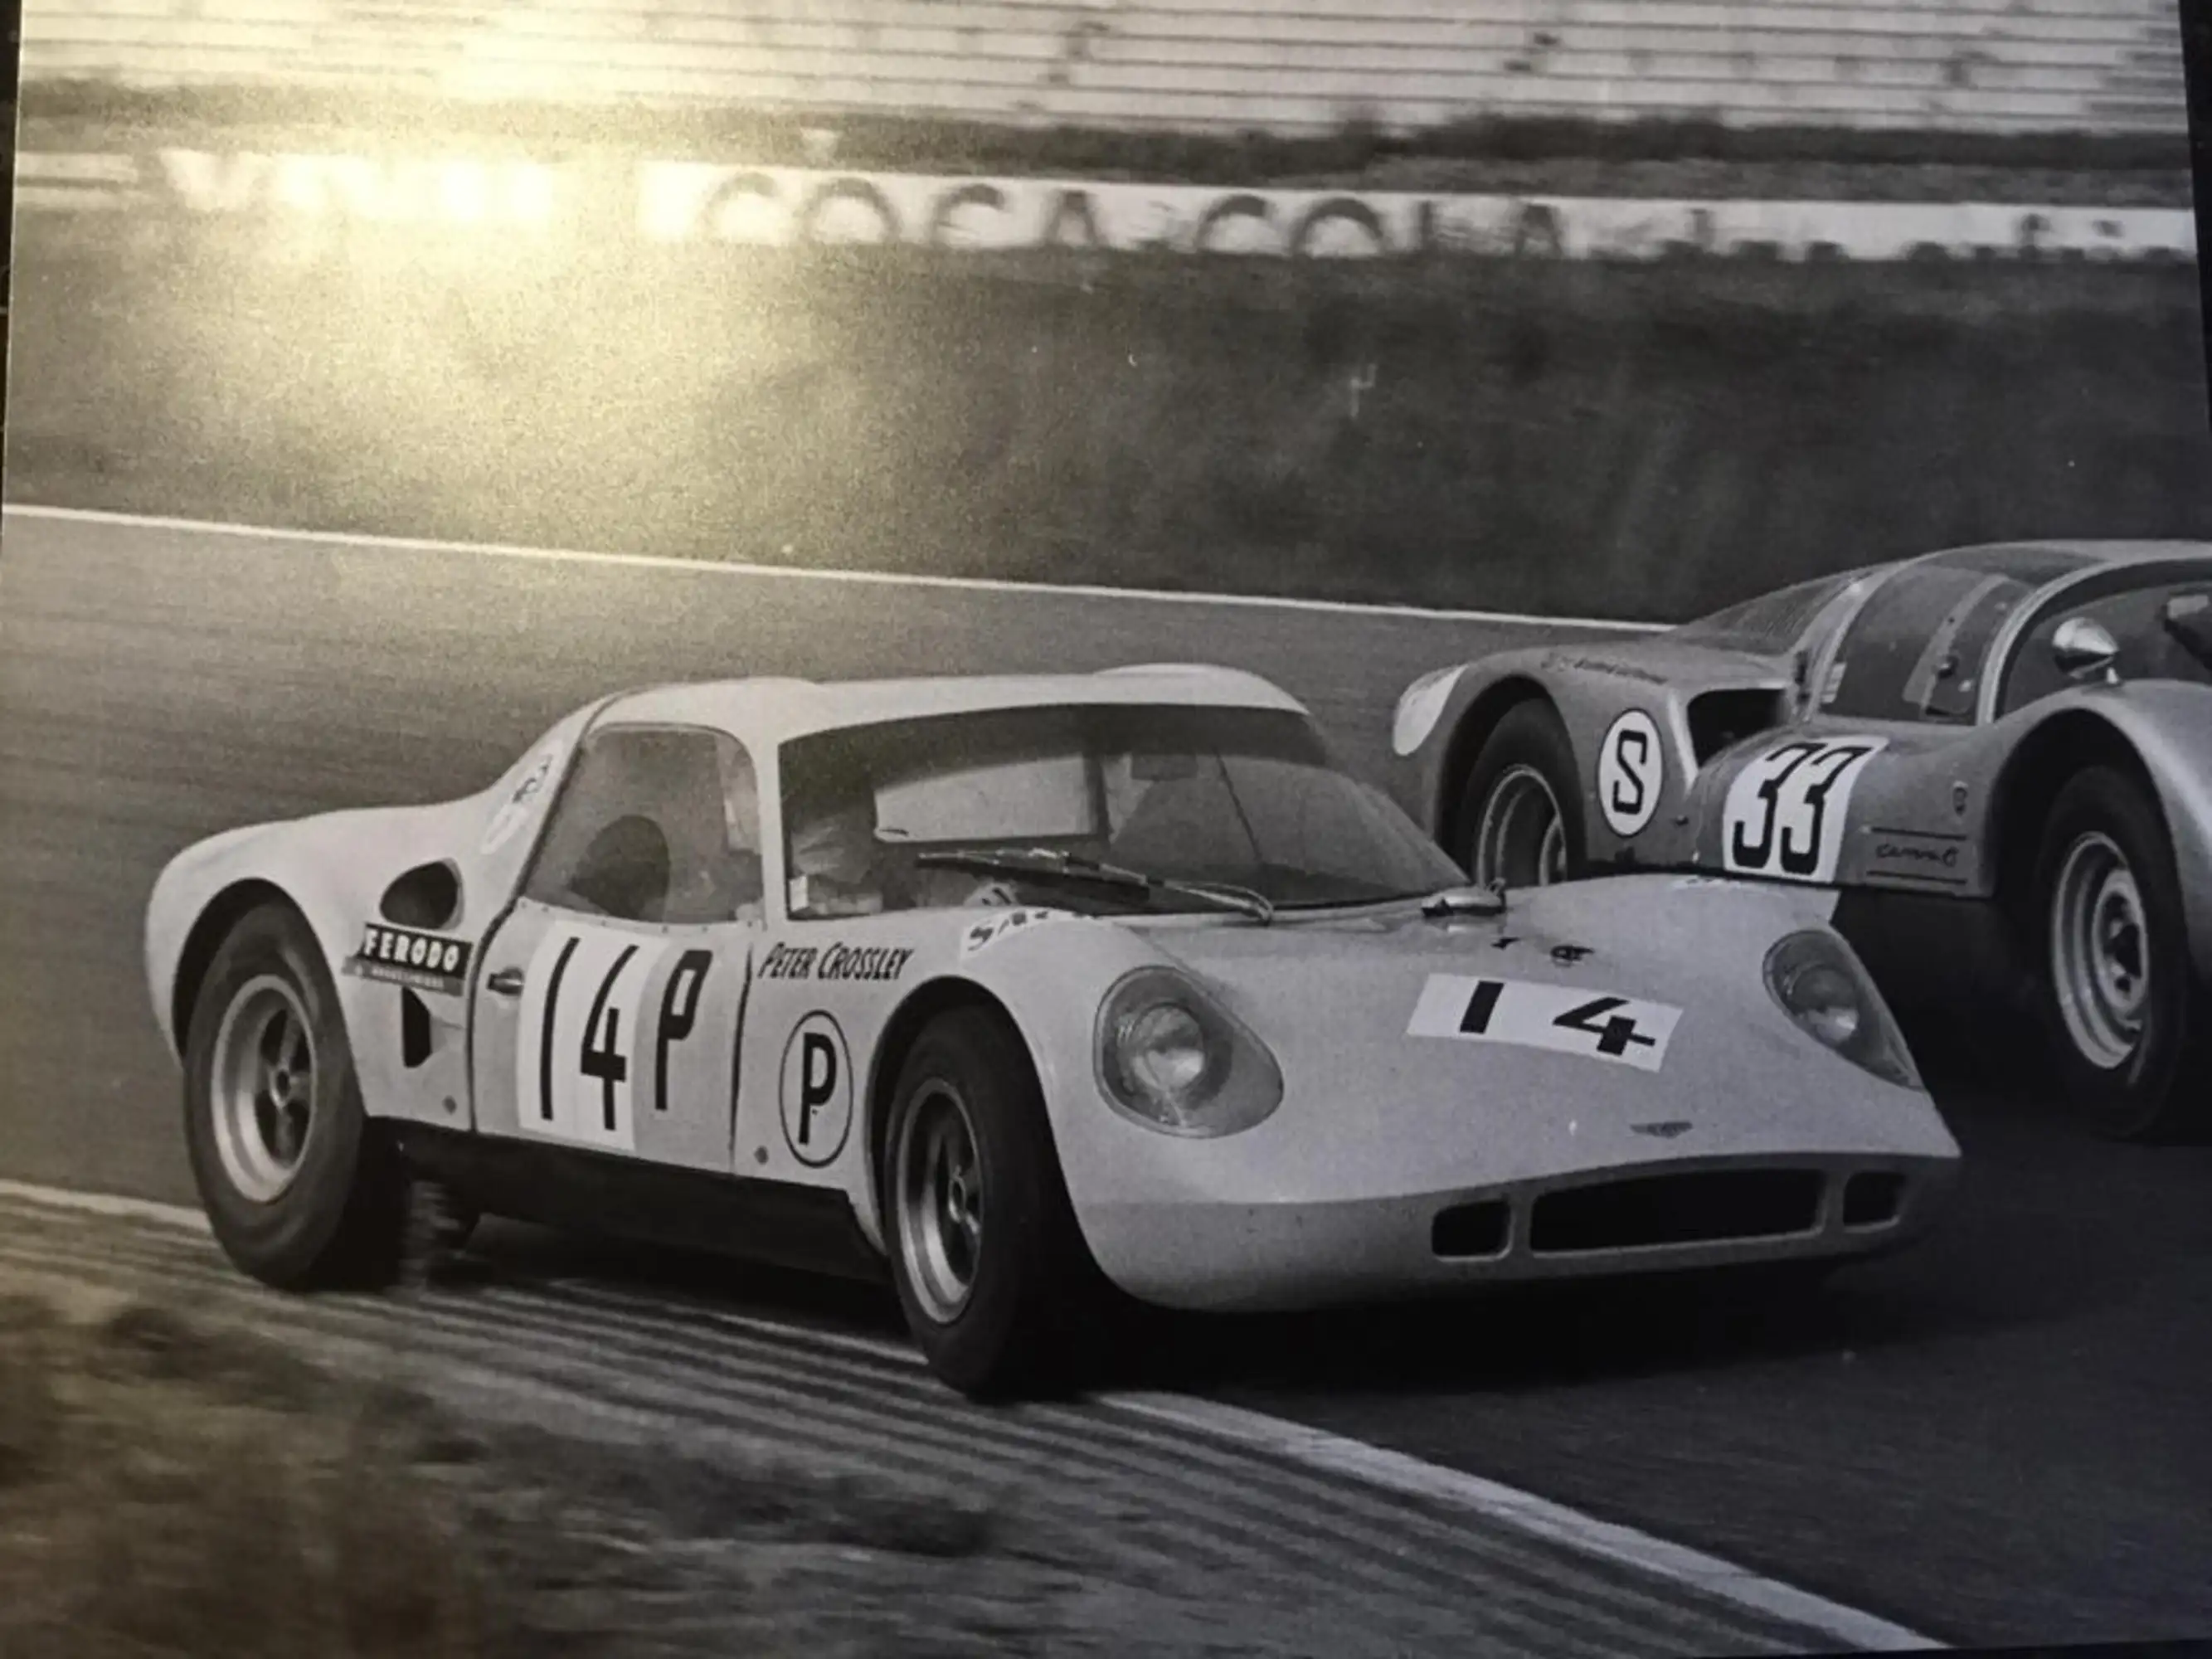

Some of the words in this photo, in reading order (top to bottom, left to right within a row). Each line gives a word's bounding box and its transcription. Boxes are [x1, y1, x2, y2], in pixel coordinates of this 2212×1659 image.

[1612, 730, 1646, 815] S
[1732, 743, 1871, 876] 33
[363, 928, 460, 972] FERODO
[757, 941, 818, 980] PETER
[818, 941, 914, 980] CROSSLEY
[798, 1032, 837, 1146] P
